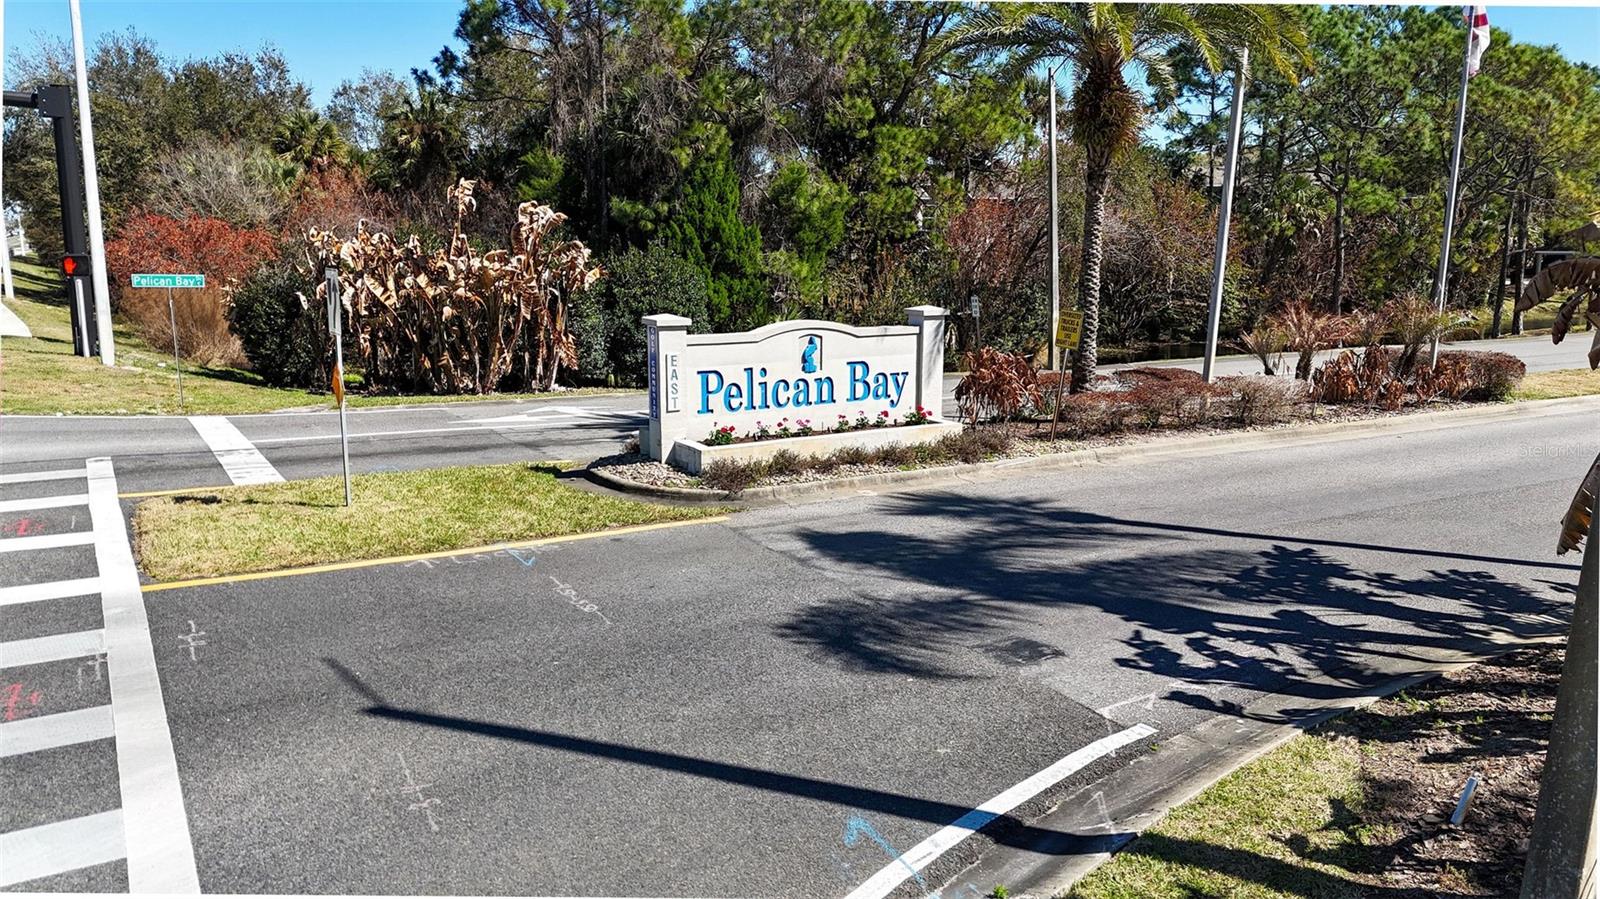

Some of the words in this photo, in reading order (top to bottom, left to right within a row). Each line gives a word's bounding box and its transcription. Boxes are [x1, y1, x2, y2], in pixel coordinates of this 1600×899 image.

[134, 276, 172, 285] Pelican
[176, 276, 195, 286] Bay
[670, 354, 679, 409] EAST
[697, 367, 836, 414] Pelican
[846, 360, 909, 408] Bay
